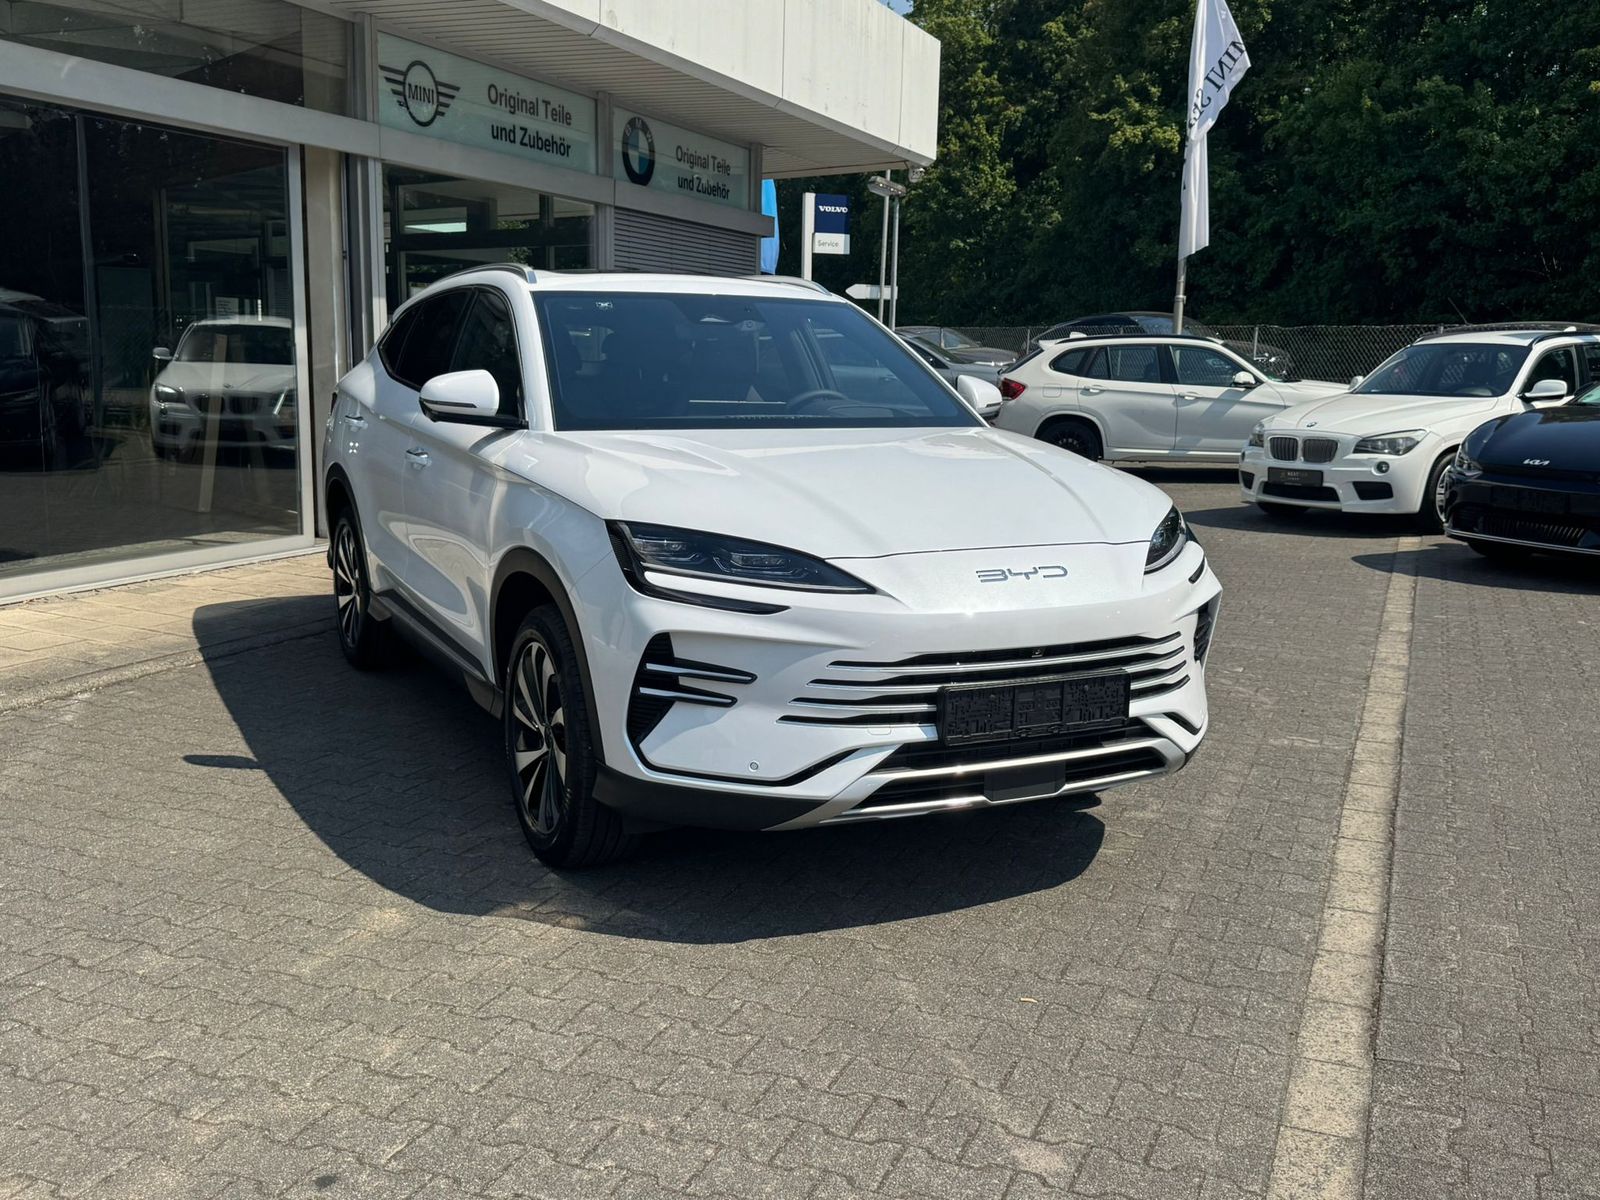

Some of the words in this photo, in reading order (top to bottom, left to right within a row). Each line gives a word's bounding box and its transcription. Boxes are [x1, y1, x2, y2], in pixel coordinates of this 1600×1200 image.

[407, 83, 435, 105] MINI
[487, 83, 539, 117] Original
[542, 100, 572, 126] Teile
[491, 124, 516, 144] und
[519, 126, 571, 158] Zubehör
[675, 145, 710, 170] Original
[711, 156, 731, 176] Teile
[677, 175, 695, 191] und
[695, 176, 730, 200] Zubehör
[818, 205, 848, 213] VOLVO
[975, 565, 1068, 583] BYD
